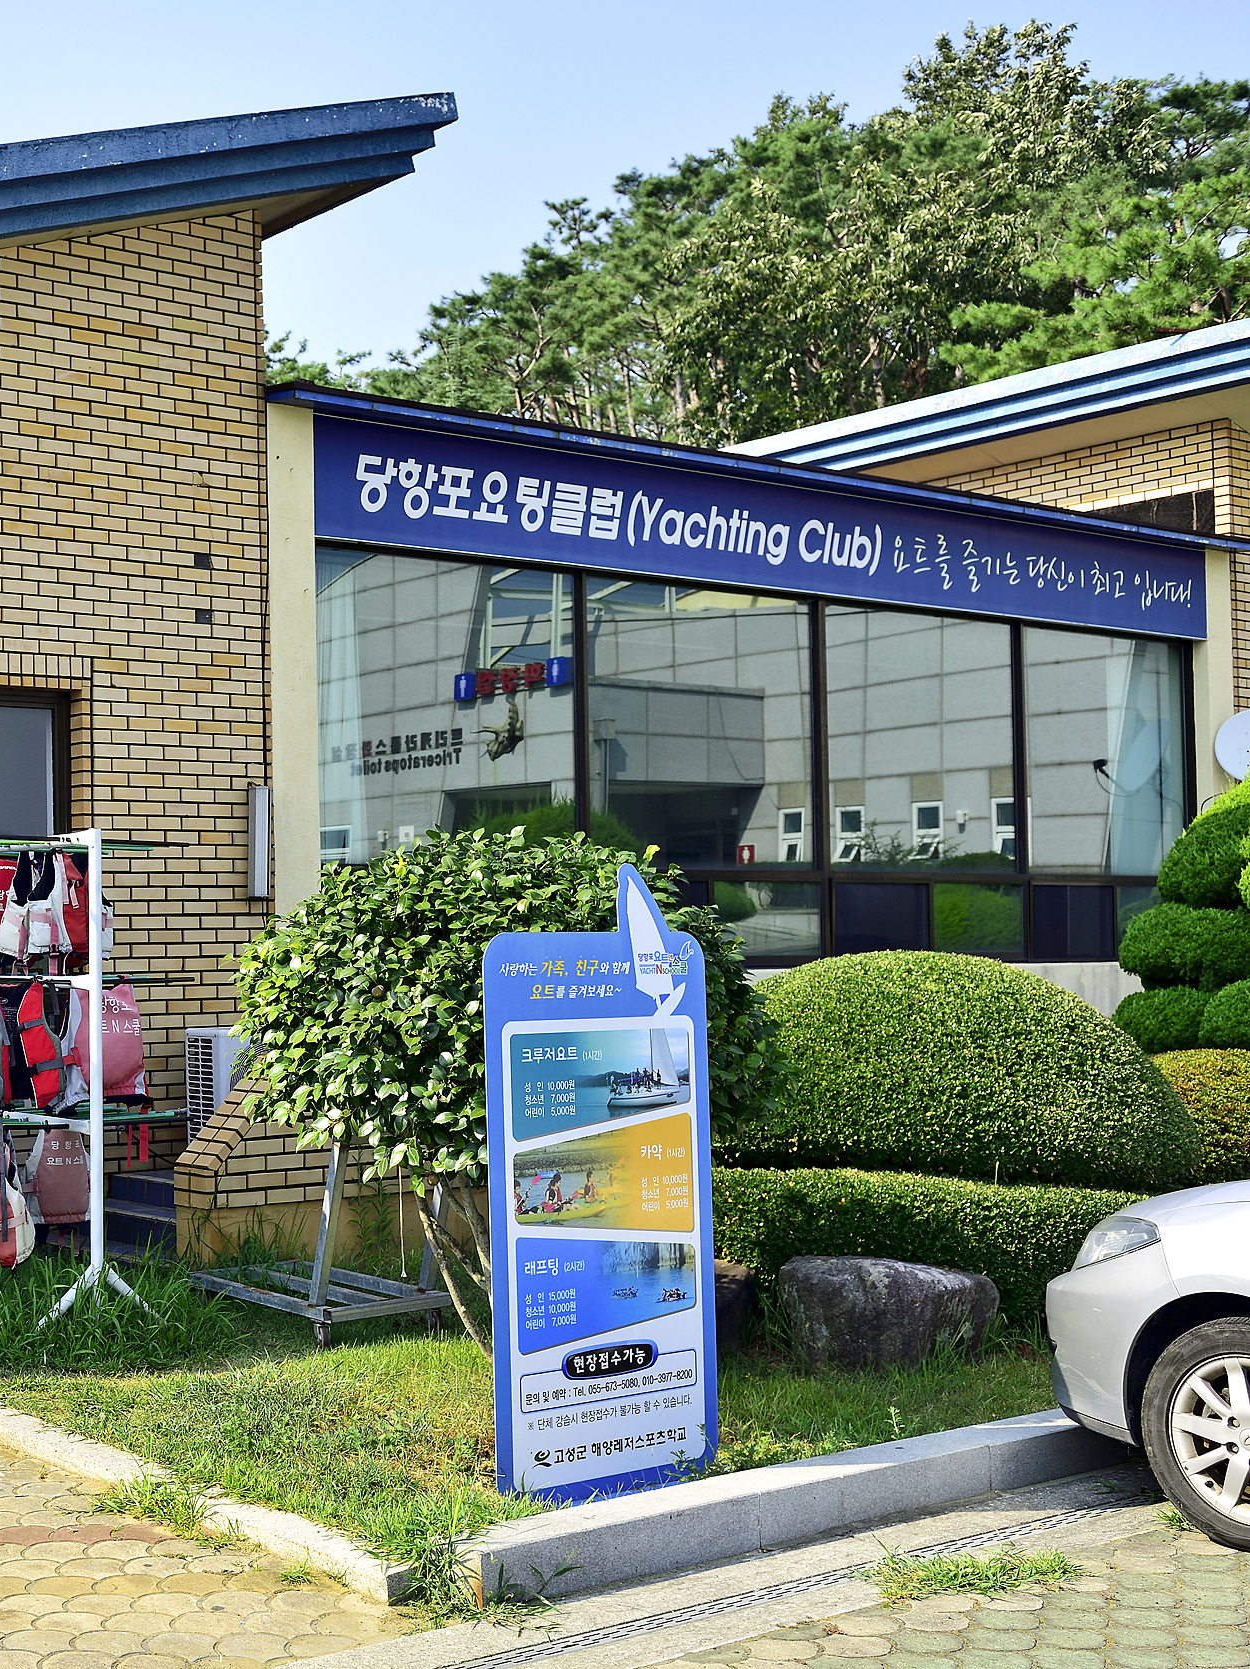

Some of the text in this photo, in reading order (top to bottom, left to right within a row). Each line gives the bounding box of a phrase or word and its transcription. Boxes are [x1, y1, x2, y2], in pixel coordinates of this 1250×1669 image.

[356, 453, 624, 541] 당항포요팅클럽
[798, 519, 882, 576] Club)
[893, 534, 953, 590] 요트를
[962, 539, 1020, 593] 즐기는
[1026, 555, 1084, 592] 당신이
[1090, 561, 1126, 598] 최고
[499, 959, 631, 977] 사랑하는 가족, 친구와 함께
[529, 984, 565, 1000] 요트를
[112, 1020, 120, 1033] N
[123, 1019, 141, 1036] 스쿨
[521, 1046, 603, 1064] 크루저요트 (1시간)
[547, 1079, 575, 1091] 10,000원
[524, 1092, 576, 1105] 청소년 7,000원
[524, 1104, 576, 1118] 어린이 5,000원
[640, 1144, 686, 1160] 카약 (1시간)
[46, 1157, 63, 1166] 요트
[662, 1173, 688, 1185] 10,000원
[642, 1185, 688, 1200] 청소년 7,000원
[642, 1197, 689, 1211] 어린이 5,000원
[524, 1258, 586, 1276] 래프팅 (2시간)
[548, 1288, 576, 1301] 15,000원
[525, 1301, 576, 1317] 청소년 10,000원
[525, 1313, 577, 1330] 어린이 7,000원
[573, 1349, 646, 1373] 현장접수가능
[525, 1392, 540, 1406] 문의
[542, 1391, 550, 1403] 및
[551, 1388, 566, 1400] 예약
[573, 1386, 586, 1397] Tel.
[642, 1368, 693, 1386] 010-3977-8200
[538, 1416, 553, 1431] 단체
[555, 1412, 579, 1428] 강습시
[581, 1406, 618, 1423] 현장접수가
[619, 1402, 641, 1417] 불가능
[643, 1400, 651, 1413] 할
[653, 1399, 661, 1410] 수
[662, 1393, 693, 1409] 있습니다.
[554, 1426, 687, 1464] 고성군 해양레저스포츠학교
